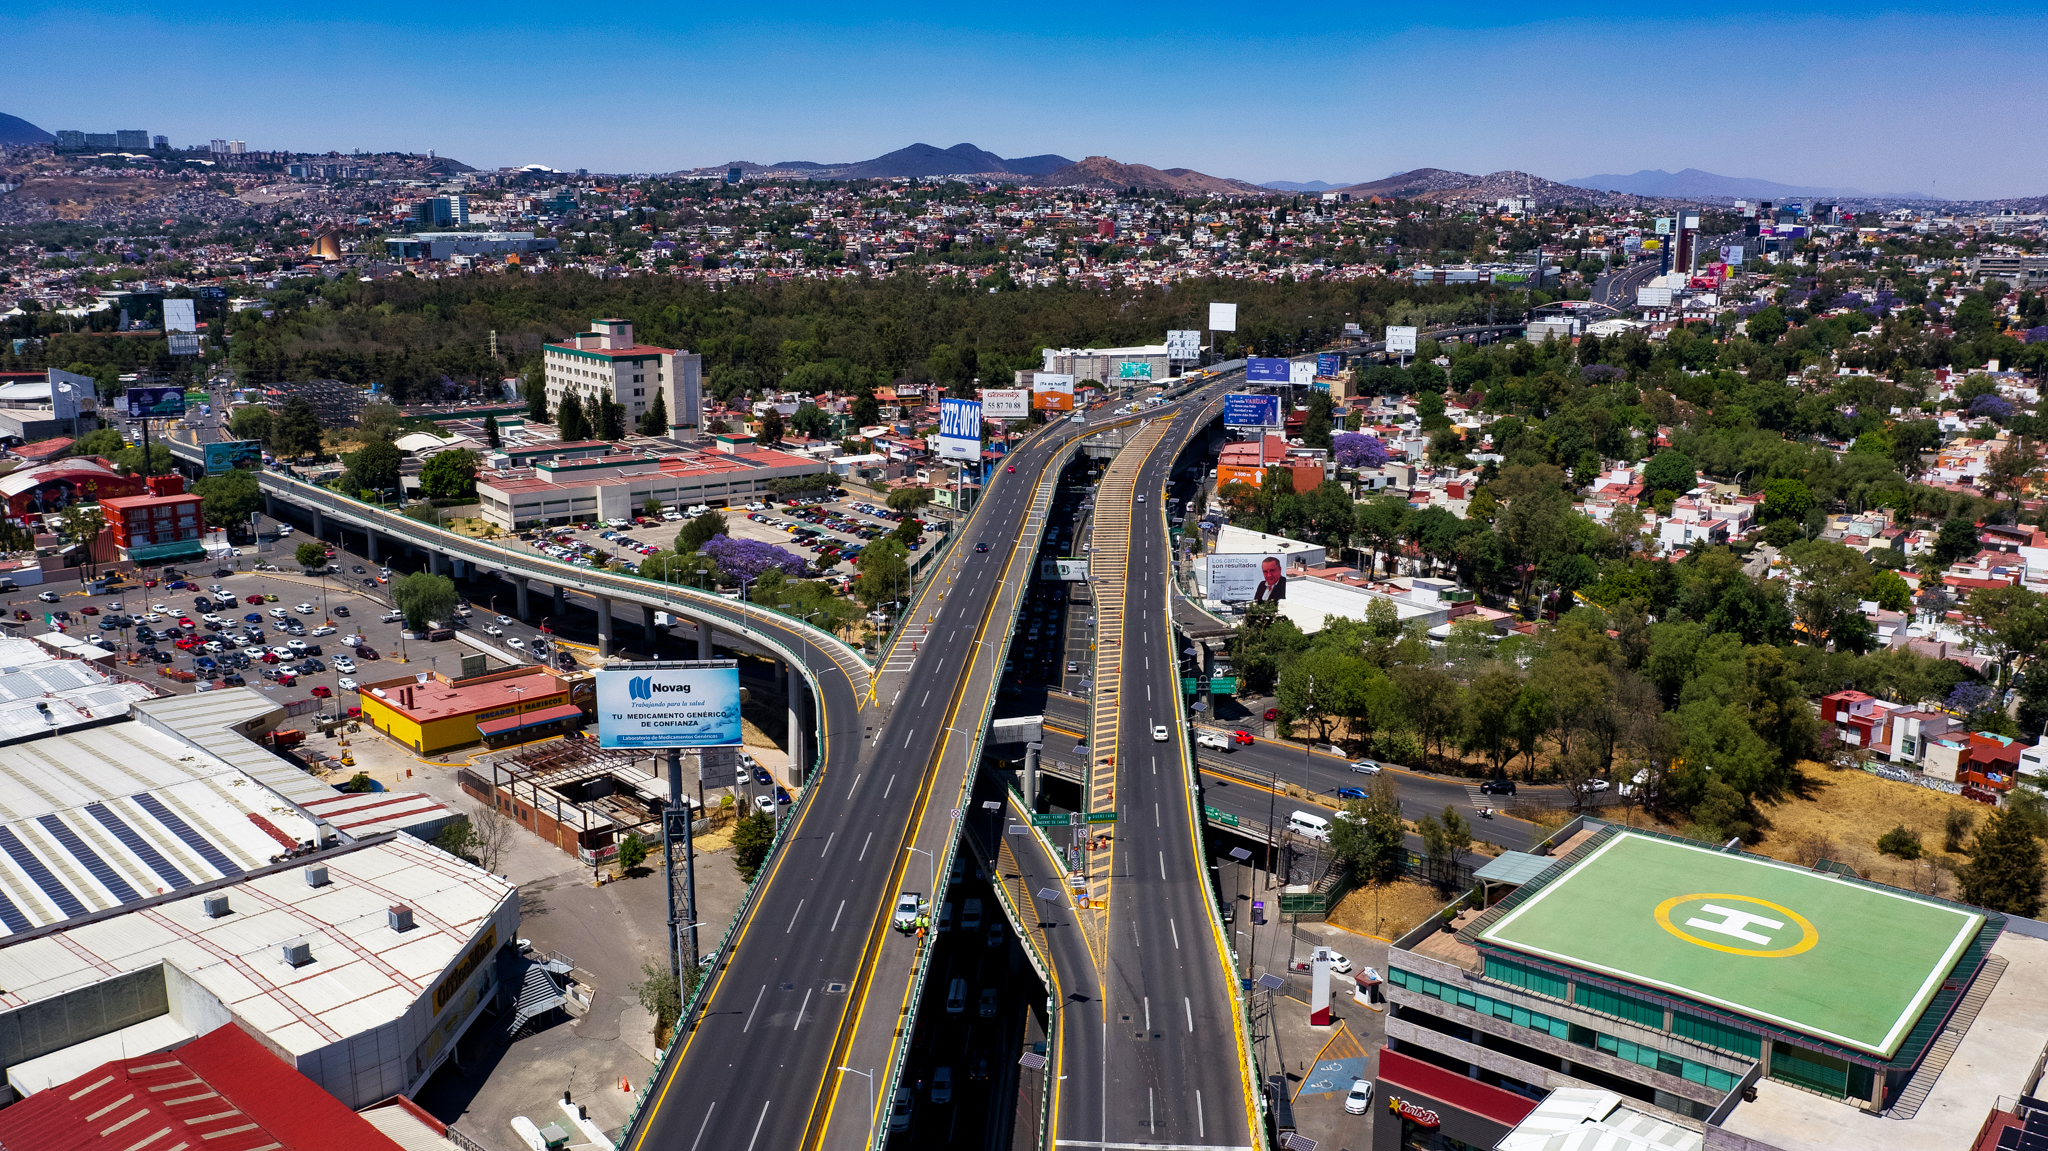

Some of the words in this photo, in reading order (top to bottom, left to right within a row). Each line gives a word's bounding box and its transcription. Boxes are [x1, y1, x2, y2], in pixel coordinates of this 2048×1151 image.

[987, 392, 1020, 400] Genemex
[941, 402, 980, 438] 5272-0018
[652, 683, 691, 693] Novag
[476, 707, 515, 720] PESCADOS
[525, 697, 562, 710] MARISCOS
[1685, 904, 1784, 946] H
[437, 935, 493, 1007] OfficeMax
